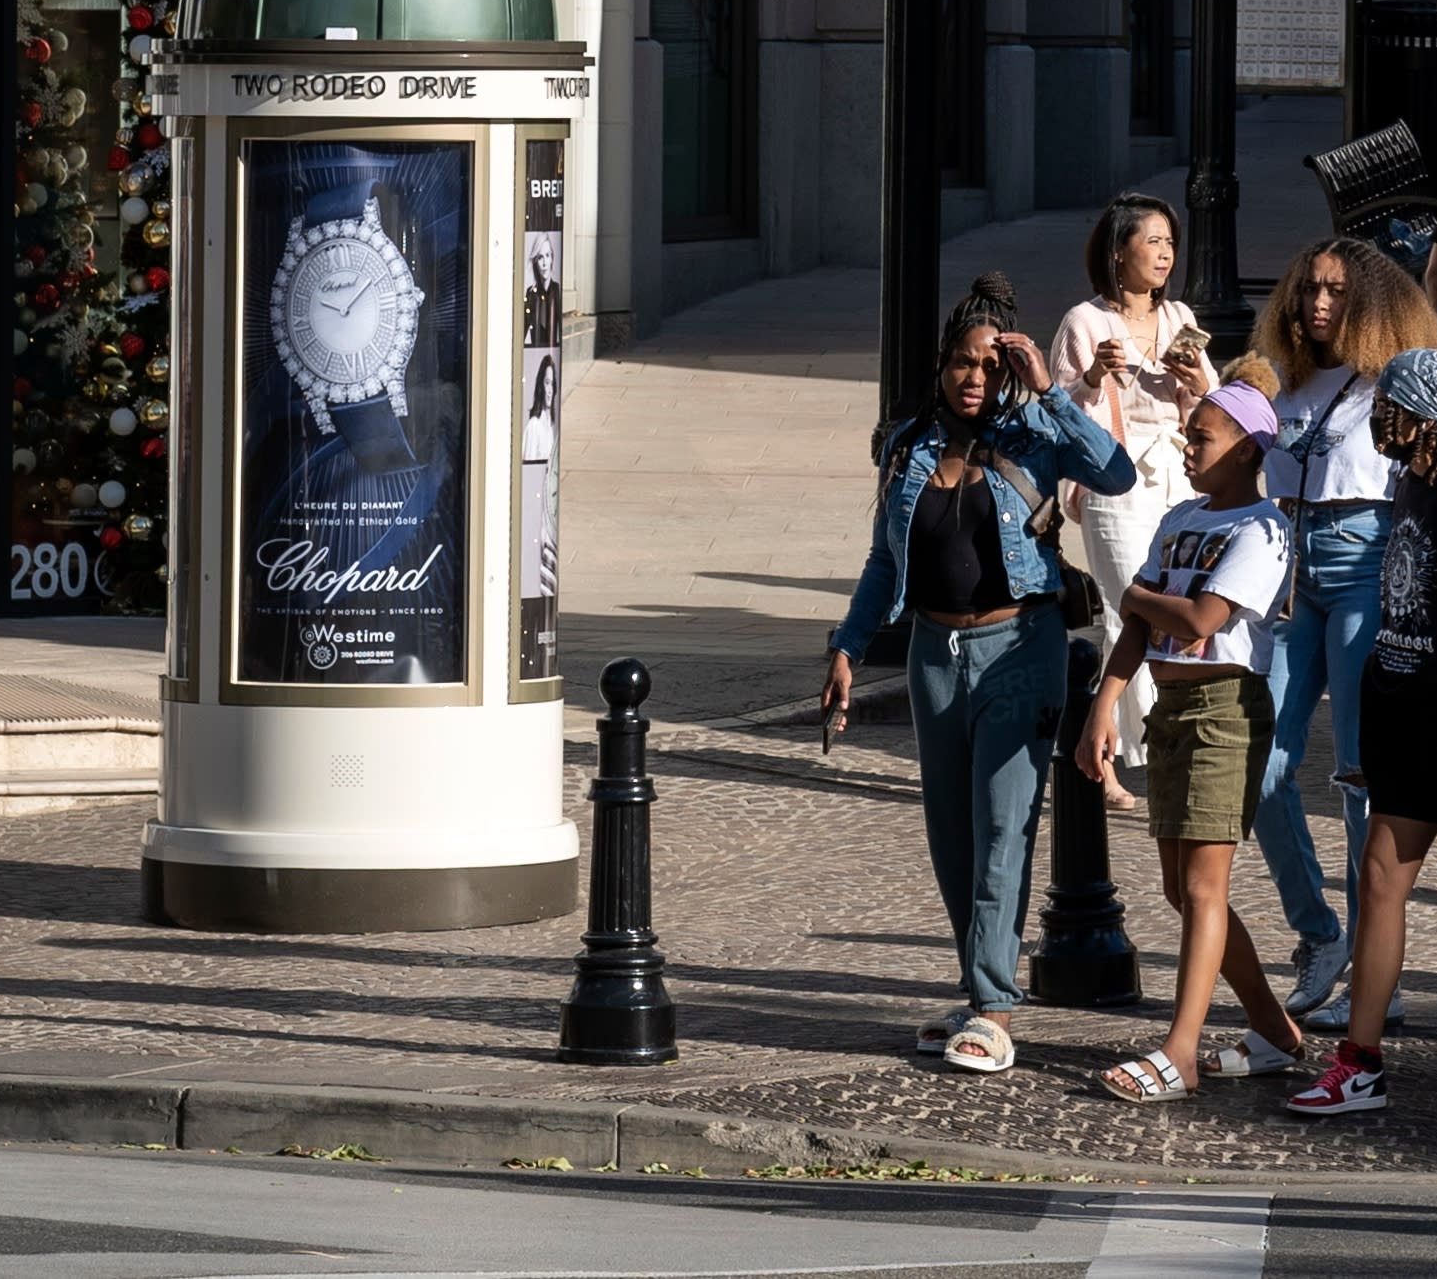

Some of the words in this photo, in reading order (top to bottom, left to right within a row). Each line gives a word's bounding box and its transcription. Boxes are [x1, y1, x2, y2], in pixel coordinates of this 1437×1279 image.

[231, 74, 282, 96] TWO
[294, 74, 387, 97] RODEO
[400, 74, 477, 97] DRIVE
[342, 502, 357, 511] DU
[361, 502, 404, 511] DIAMANT
[395, 516, 418, 526] Gold
[10, 541, 89, 601] 280
[256, 538, 444, 604] Chopard
[389, 607, 416, 615] SINCE
[312, 623, 396, 643] Westime
